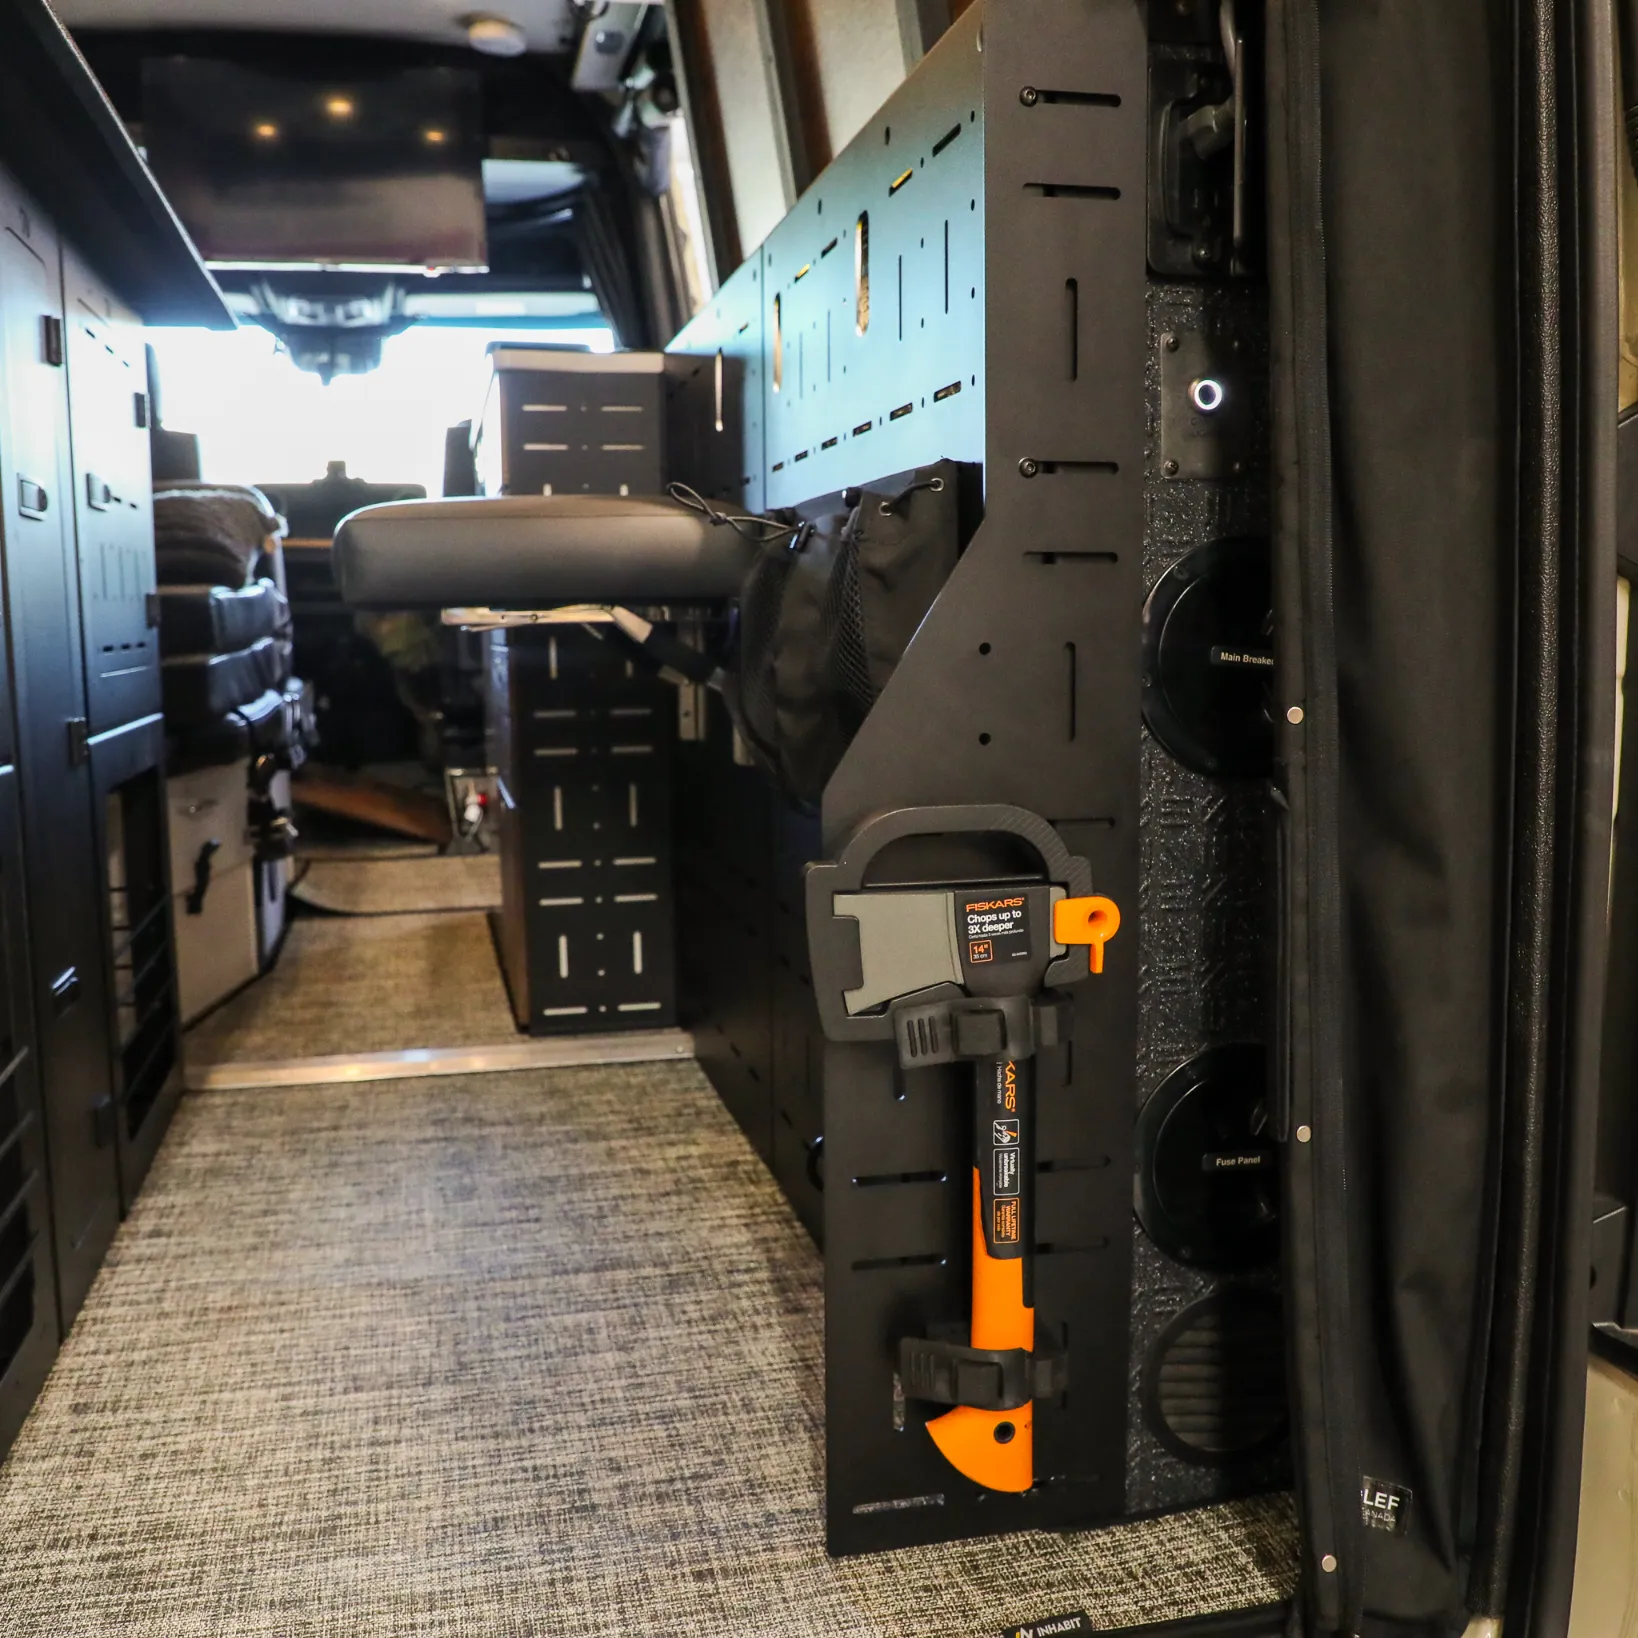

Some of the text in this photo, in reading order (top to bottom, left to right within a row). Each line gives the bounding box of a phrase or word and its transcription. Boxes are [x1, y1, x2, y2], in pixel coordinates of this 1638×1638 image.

[1220, 651, 1241, 662] Main
[966, 897, 1023, 912] FISKARS
[967, 910, 1022, 924] Chops up to
[968, 922, 1014, 934] 3X deeper
[973, 944, 988, 953] 14"
[1005, 1060, 1016, 1110] KARS
[1008, 1152, 1016, 1175] Virtually
[1216, 1156, 1261, 1167] Fuse Panel
[1361, 1488, 1400, 1510] LEF
[1036, 1617, 1081, 1637] INHABIT
